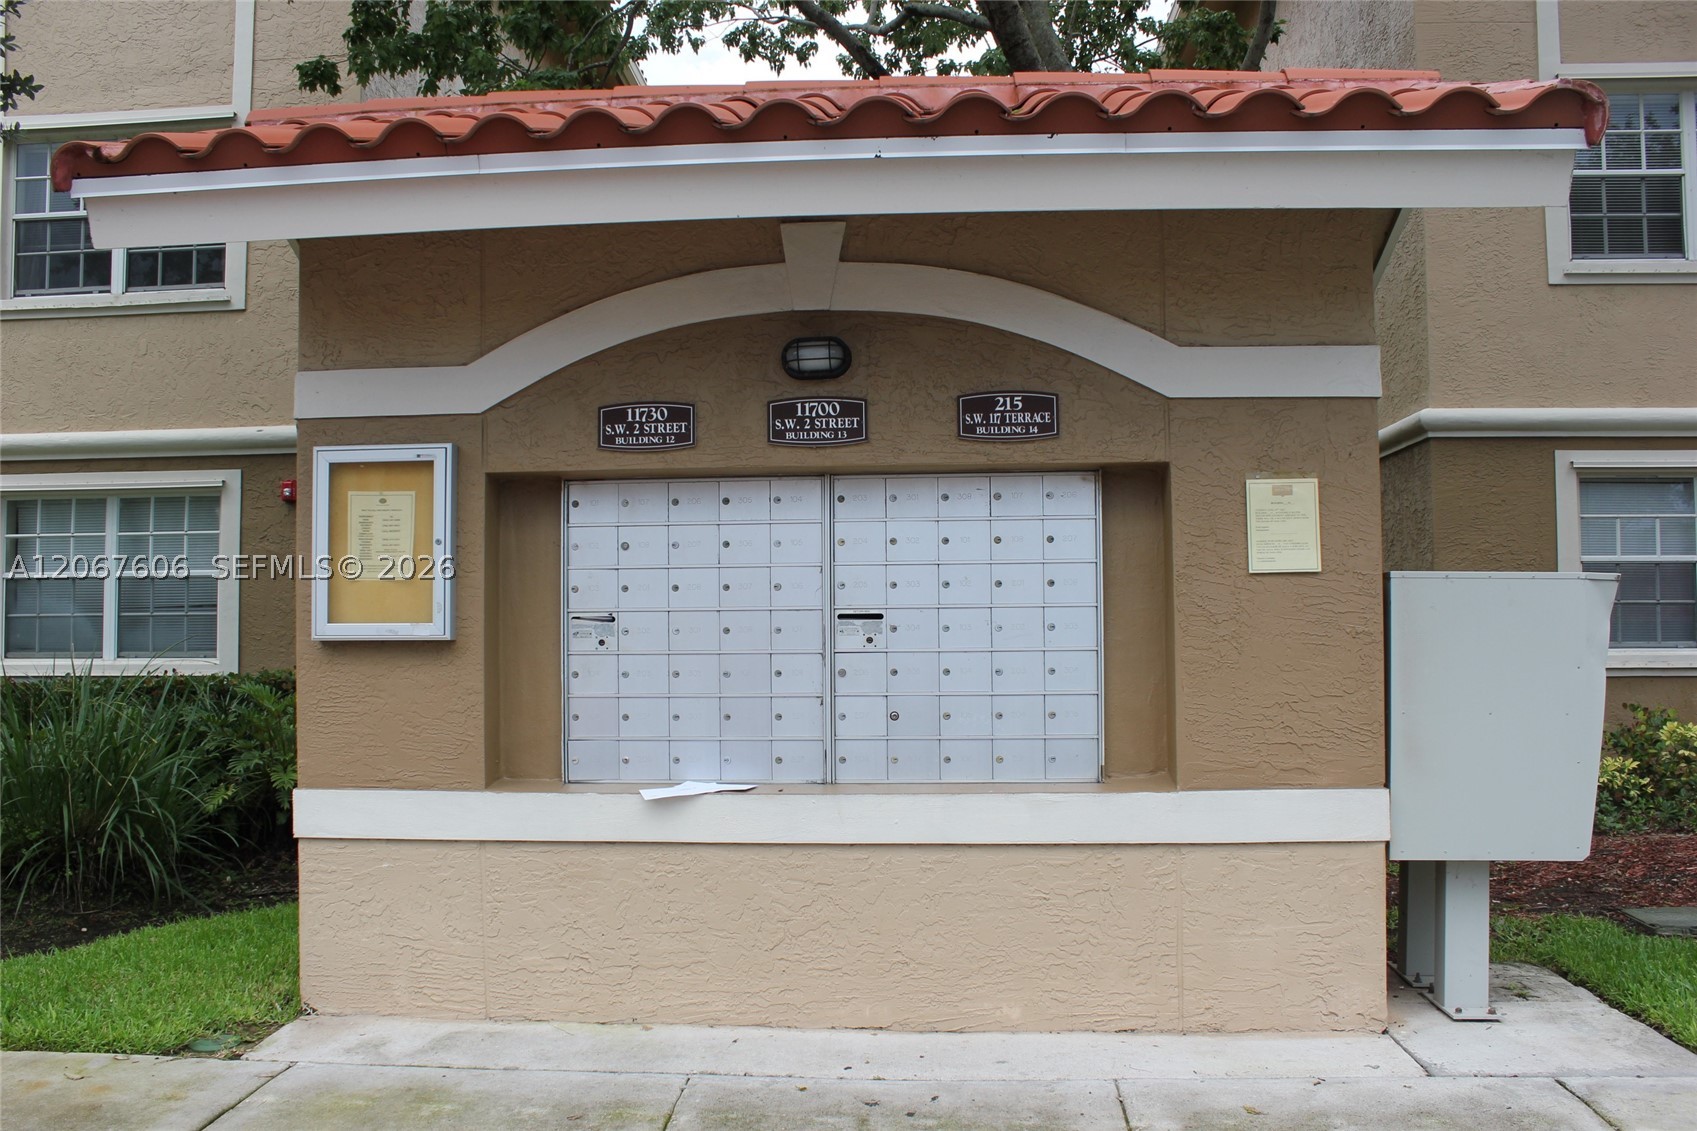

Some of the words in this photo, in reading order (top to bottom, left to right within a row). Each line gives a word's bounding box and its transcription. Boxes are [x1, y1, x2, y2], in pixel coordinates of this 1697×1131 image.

[795, 402, 840, 417] 11700
[994, 396, 1023, 411] 215
[626, 407, 668, 422] 11730
[965, 413, 986, 424] S.W.
[990, 413, 1002, 424] 117
[1003, 412, 1051, 423] TERRACE
[605, 424, 629, 435] S.W.
[633, 423, 640, 434] 2
[643, 422, 688, 434] STREET
[775, 418, 800, 430] S.W.
[804, 418, 811, 429] 2
[814, 417, 860, 429] STREET
[976, 426, 1026, 434] BUILDING
[1029, 425, 1038, 434] 14
[615, 436, 663, 445] BUILDING
[666, 435, 675, 443] 12
[785, 431, 834, 439] BUILDING
[838, 431, 847, 439] 13
